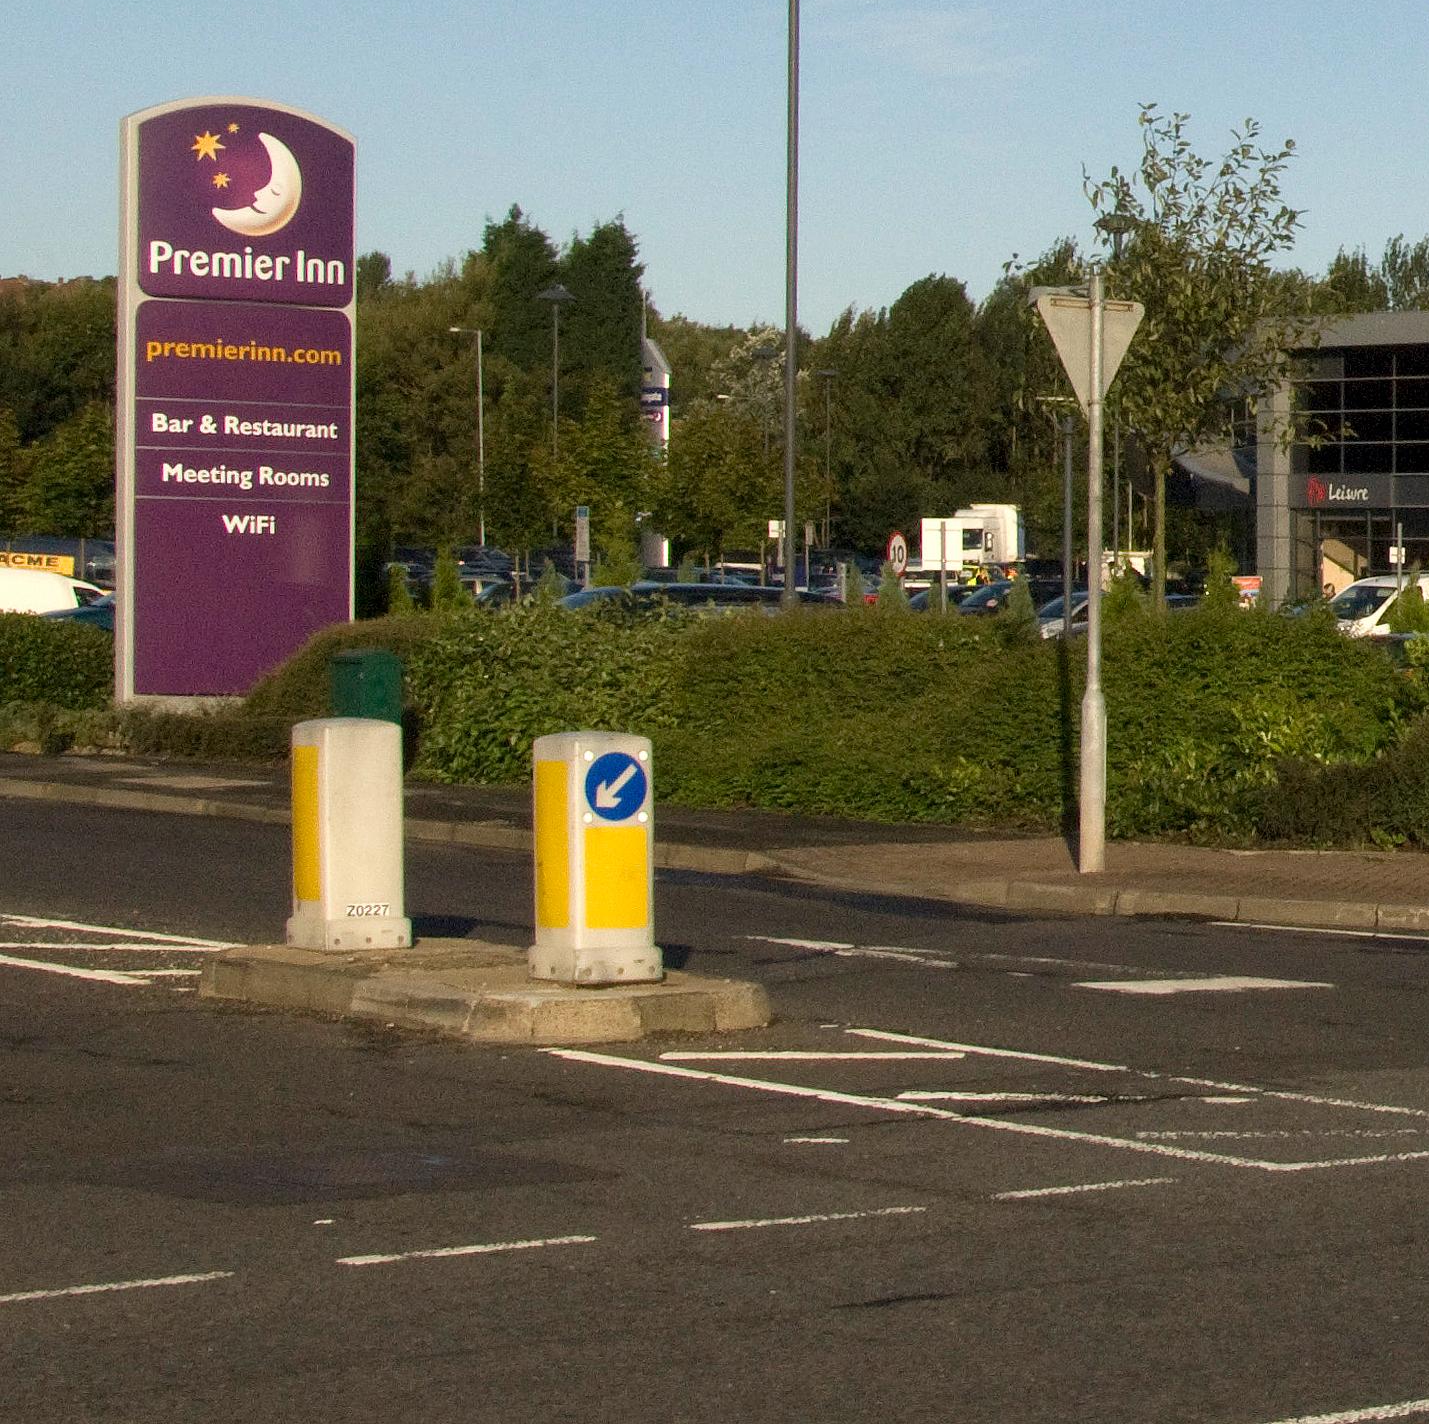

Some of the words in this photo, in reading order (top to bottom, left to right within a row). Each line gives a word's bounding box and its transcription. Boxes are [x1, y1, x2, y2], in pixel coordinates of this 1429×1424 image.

[150, 240, 290, 281] Premier
[296, 250, 345, 285] Inn
[146, 338, 342, 366] premierinn.com
[152, 412, 193, 434] Bar
[199, 414, 217, 434] &
[224, 416, 338, 439] Restaurant
[162, 463, 253, 490] Meeting
[258, 465, 330, 487] Rooms
[1328, 483, 1369, 501] Leisure
[222, 514, 276, 535] WiFi
[891, 545, 904, 564] 10
[346, 904, 389, 917] Z0227
